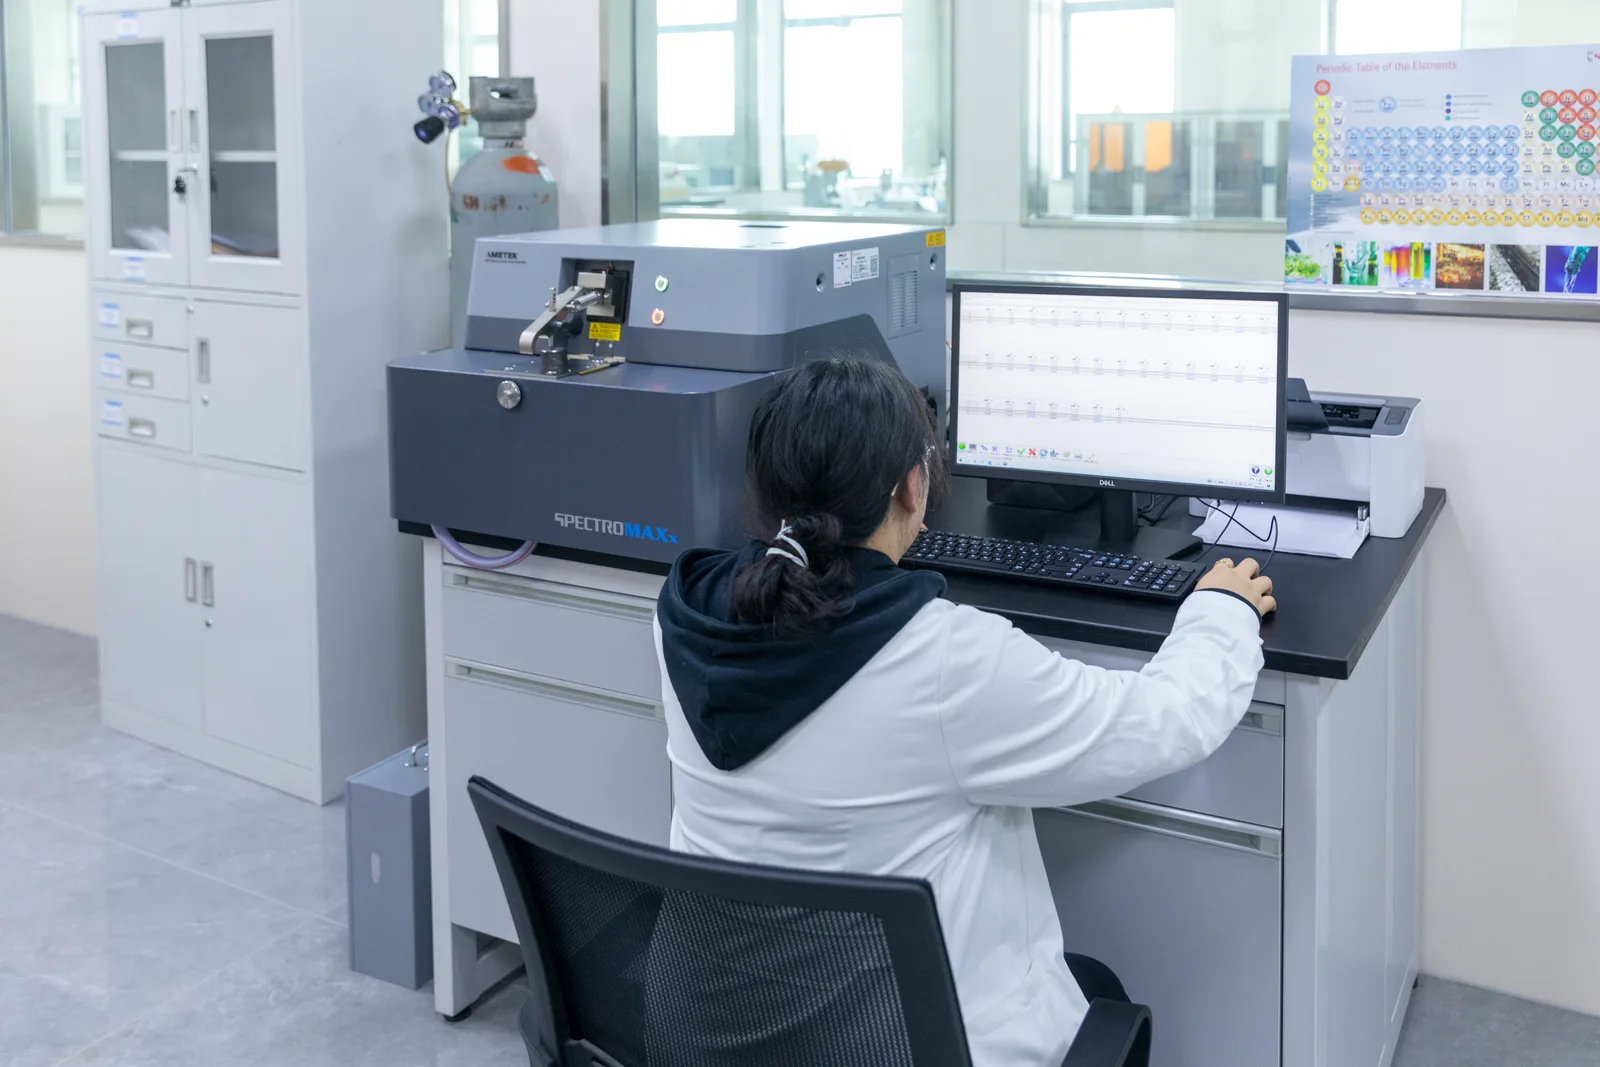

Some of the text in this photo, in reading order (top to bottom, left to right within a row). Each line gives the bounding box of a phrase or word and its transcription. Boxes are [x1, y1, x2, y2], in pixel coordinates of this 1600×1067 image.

[1316, 60, 1457, 74] Periodic Table of the Elements
[486, 251, 518, 260] AMETEK
[1099, 479, 1115, 487] DELL
